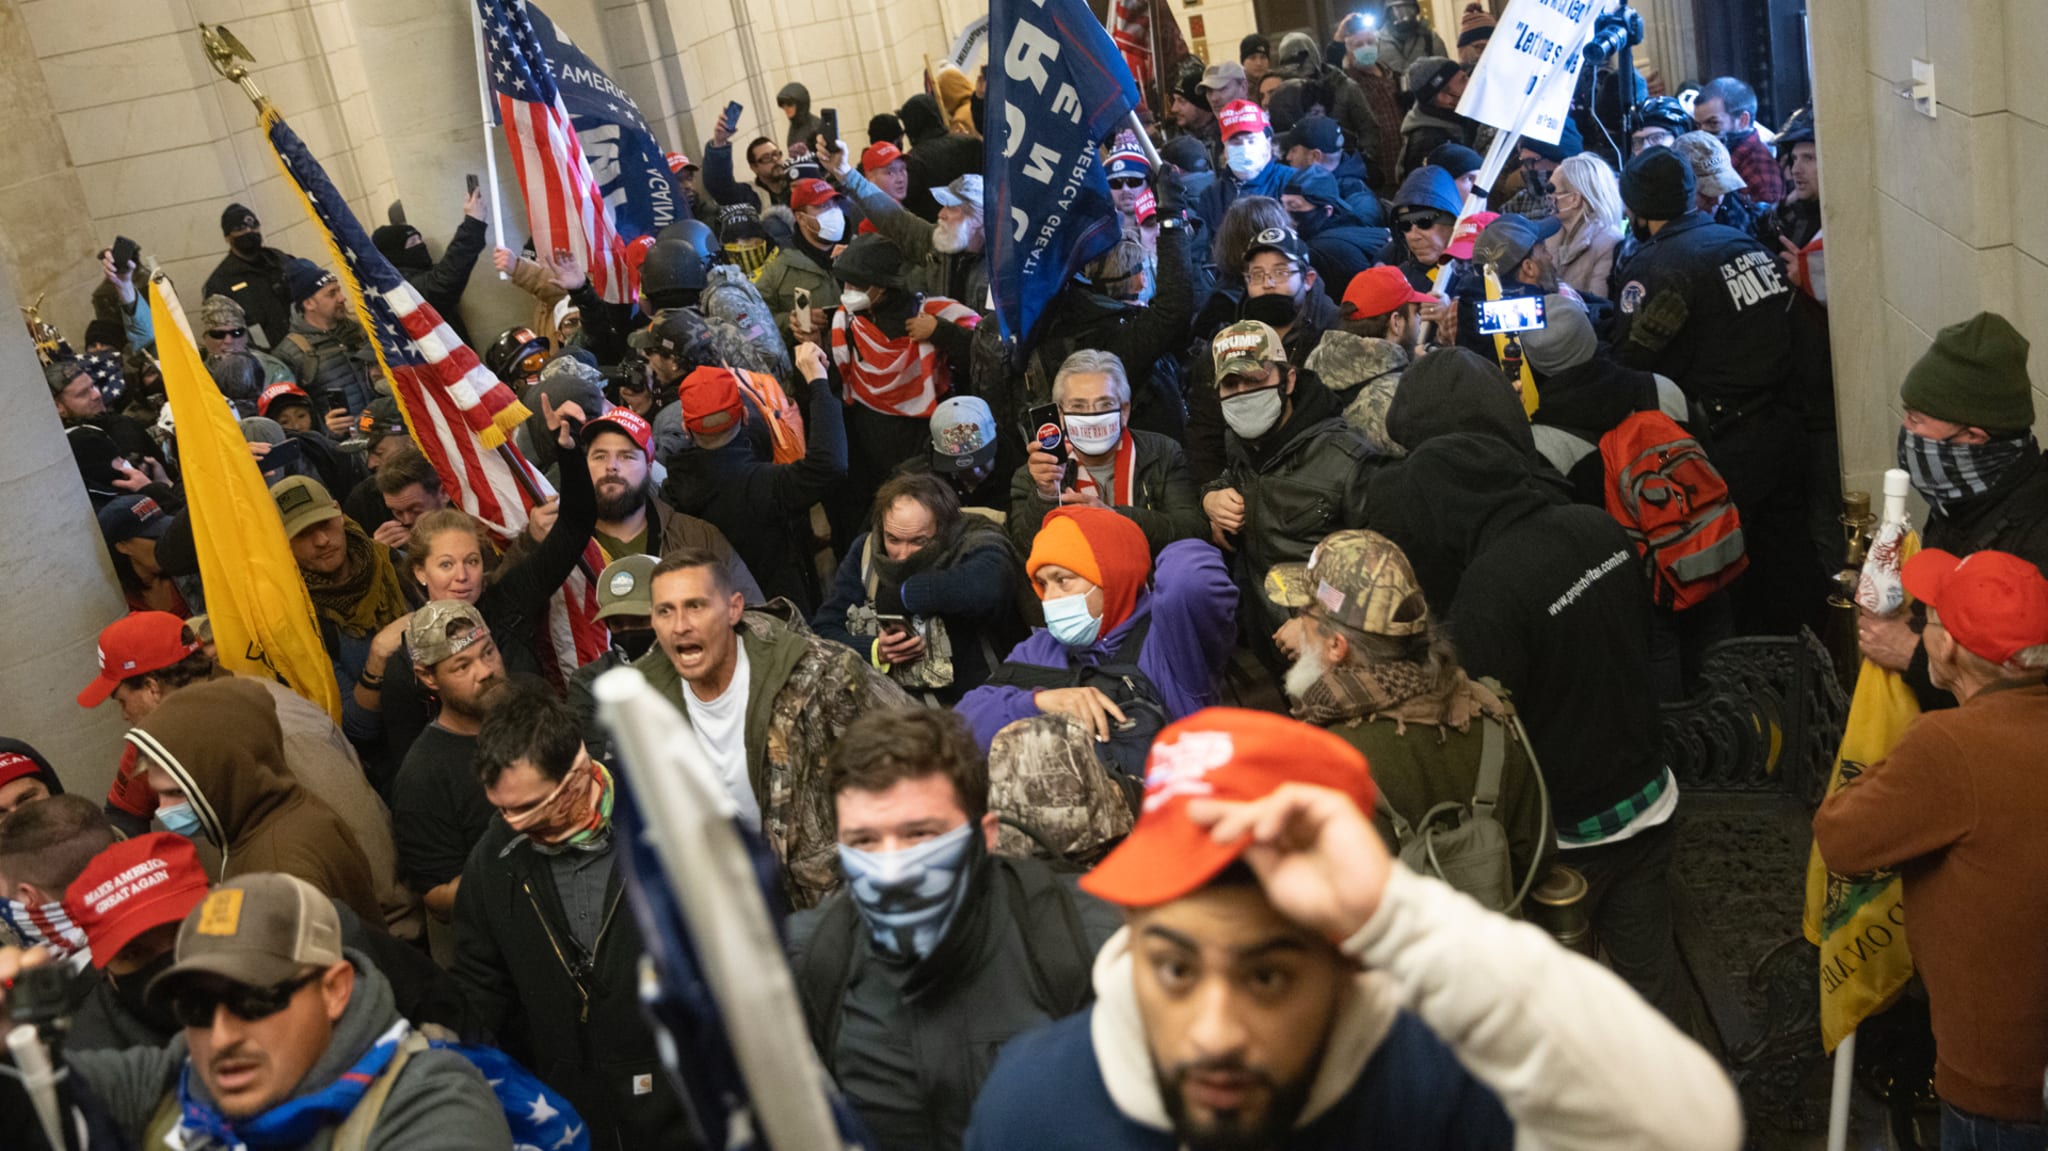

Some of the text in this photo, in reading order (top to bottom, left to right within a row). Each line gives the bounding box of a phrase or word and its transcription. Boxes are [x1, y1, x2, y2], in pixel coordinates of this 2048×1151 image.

[1726, 262, 1789, 311] POLICE
[1215, 334, 1263, 354] TRUMP
[83, 879, 115, 907] MAKE
[95, 869, 170, 916] GREAT AGAIN
